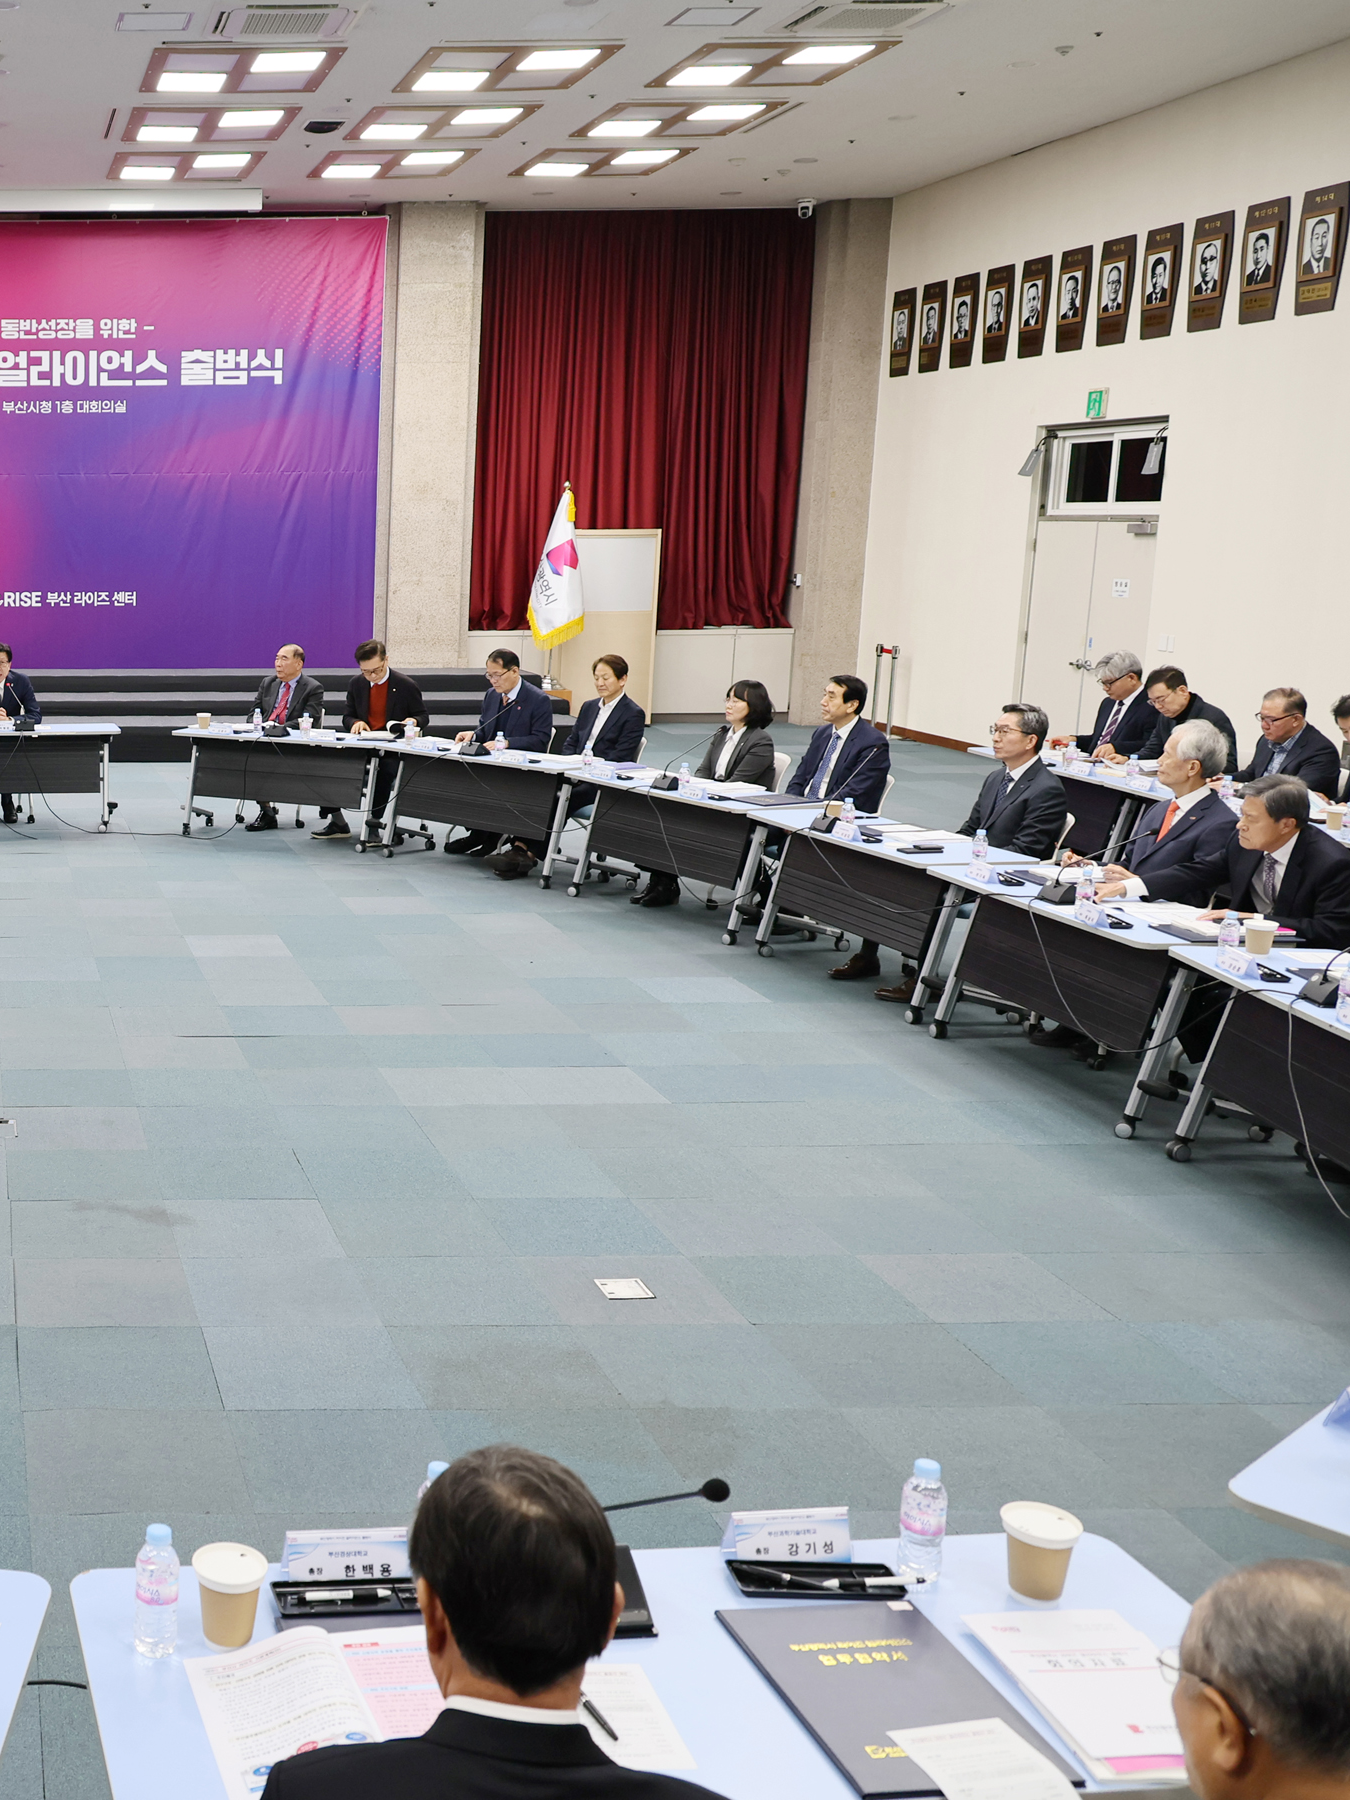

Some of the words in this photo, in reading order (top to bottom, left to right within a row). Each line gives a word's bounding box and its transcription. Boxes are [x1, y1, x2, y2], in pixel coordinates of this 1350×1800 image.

[0, 318, 94, 339] 동반성장을
[100, 317, 137, 338] 위한
[180, 348, 284, 386] 출범식
[2, 400, 52, 414] 부산시청
[55, 400, 73, 414] 1층
[77, 400, 127, 414] 대회의실
[4, 592, 41, 607] RISE
[46, 592, 71, 607] 부산
[73, 592, 110, 607] 라이즈
[112, 591, 137, 607] 센터
[755, 1547, 770, 1556] 총장
[788, 1541, 835, 1557] 강기성
[308, 1567, 323, 1576] 총장
[344, 1563, 392, 1578] 한백용
